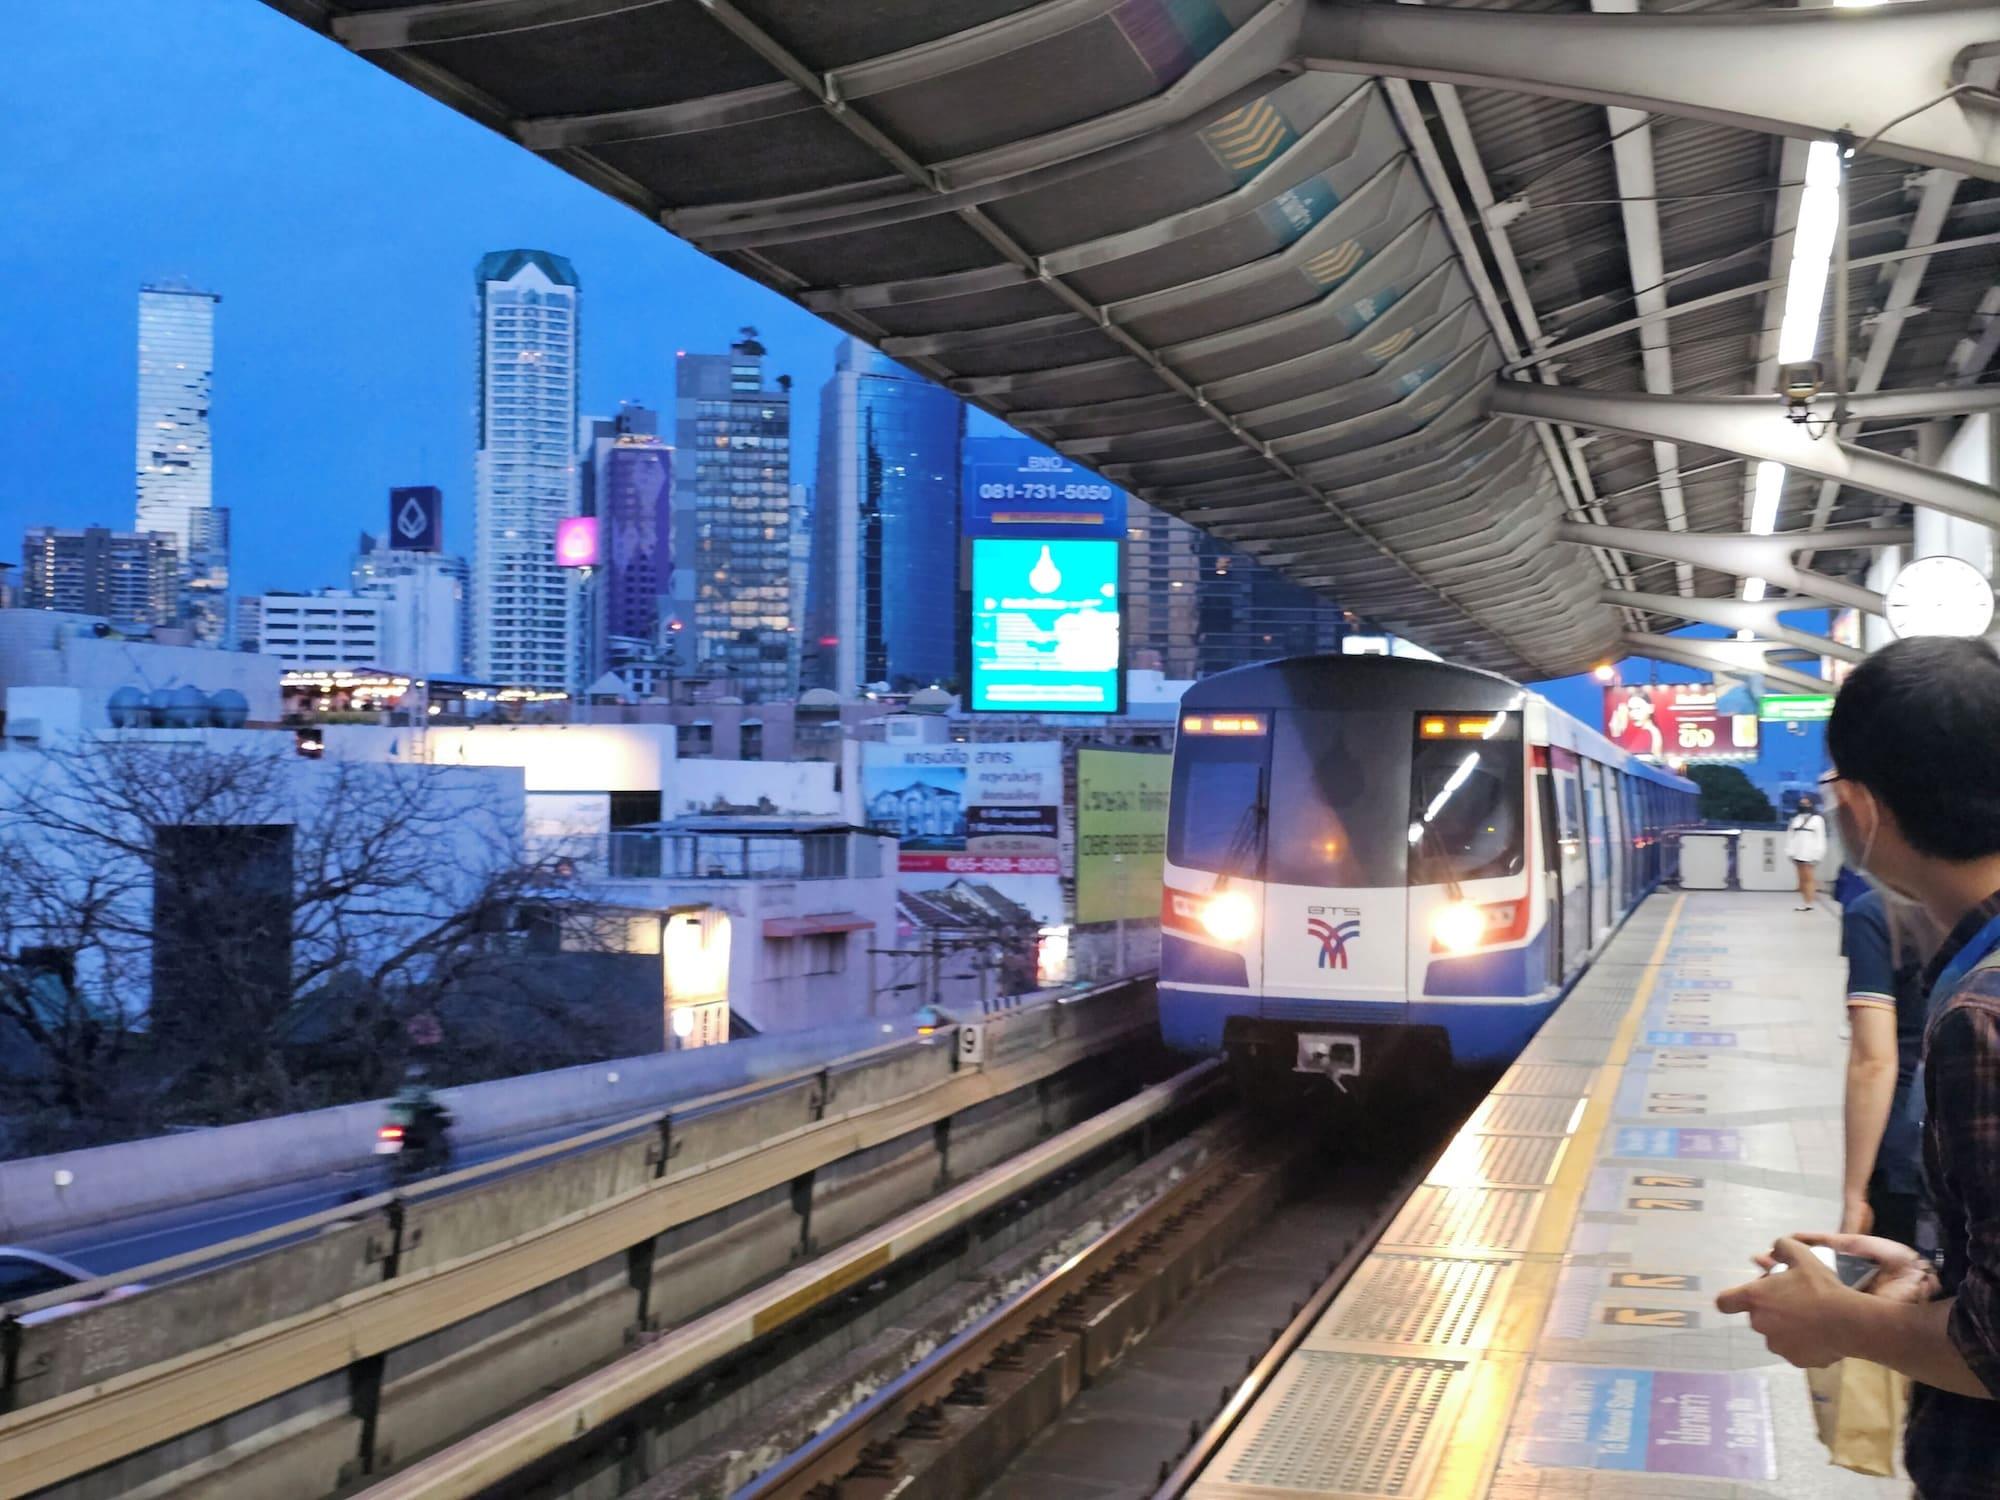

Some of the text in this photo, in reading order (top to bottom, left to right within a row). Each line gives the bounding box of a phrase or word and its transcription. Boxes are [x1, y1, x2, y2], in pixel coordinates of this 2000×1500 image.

[979, 483, 1112, 500] 081-731-5050
[1307, 905, 1361, 917] BTS
[961, 1027, 977, 1054] 9
